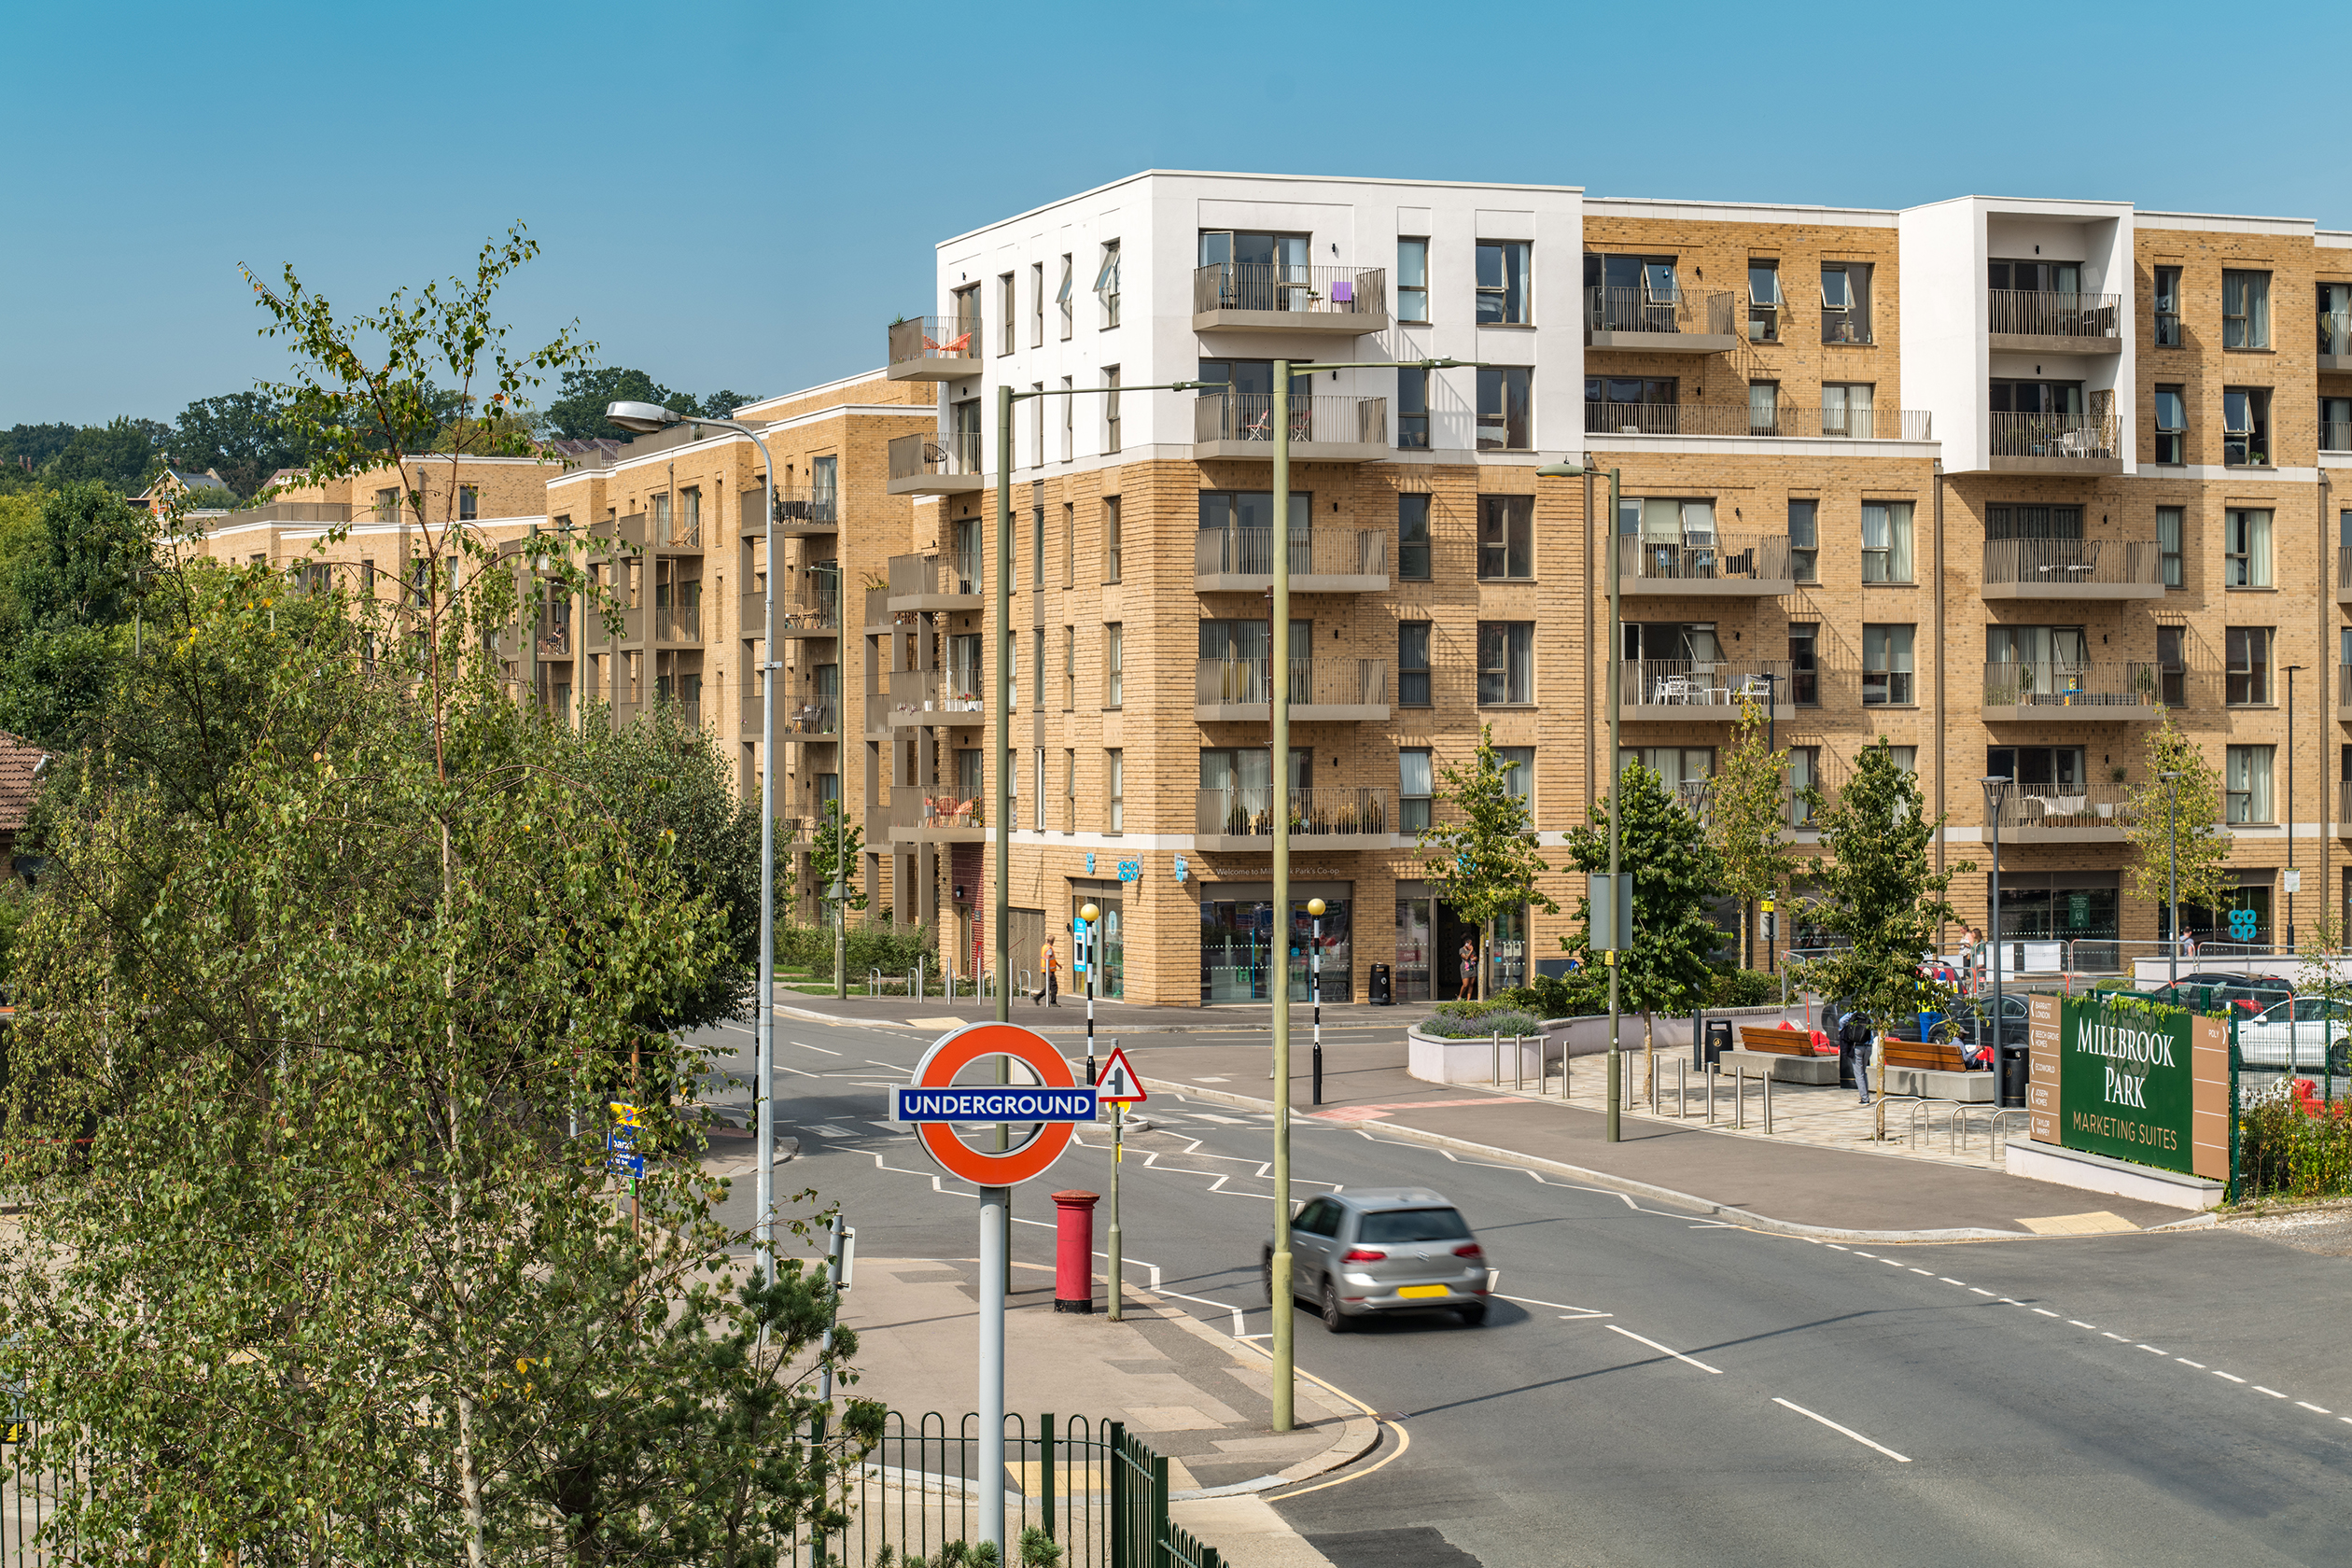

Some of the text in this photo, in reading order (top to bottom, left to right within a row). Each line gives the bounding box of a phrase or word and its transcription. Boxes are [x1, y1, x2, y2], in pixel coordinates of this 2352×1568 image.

[1295, 867, 1316, 875] Park's
[1317, 867, 1340, 875] Co-op
[2035, 1001, 2051, 1011] BARRATT
[2035, 1010, 2051, 1019] LONDON
[2035, 1029, 2060, 1042] BEECH GROVE
[2208, 1029, 2220, 1039] POLY
[2035, 1039, 2048, 1048] HOMES
[2035, 1062, 2056, 1074] ECOWORLD
[2105, 1066, 2147, 1109] PARK
[2035, 1088, 2049, 1098] JOSEPH
[904, 1095, 1090, 1114] UNDERGROUND
[2035, 1098, 2048, 1107] HOMES
[2036, 1117, 2051, 1128] TAYLOR
[2073, 1111, 2135, 1142] MARKETING
[2138, 1124, 2177, 1151] SUITES
